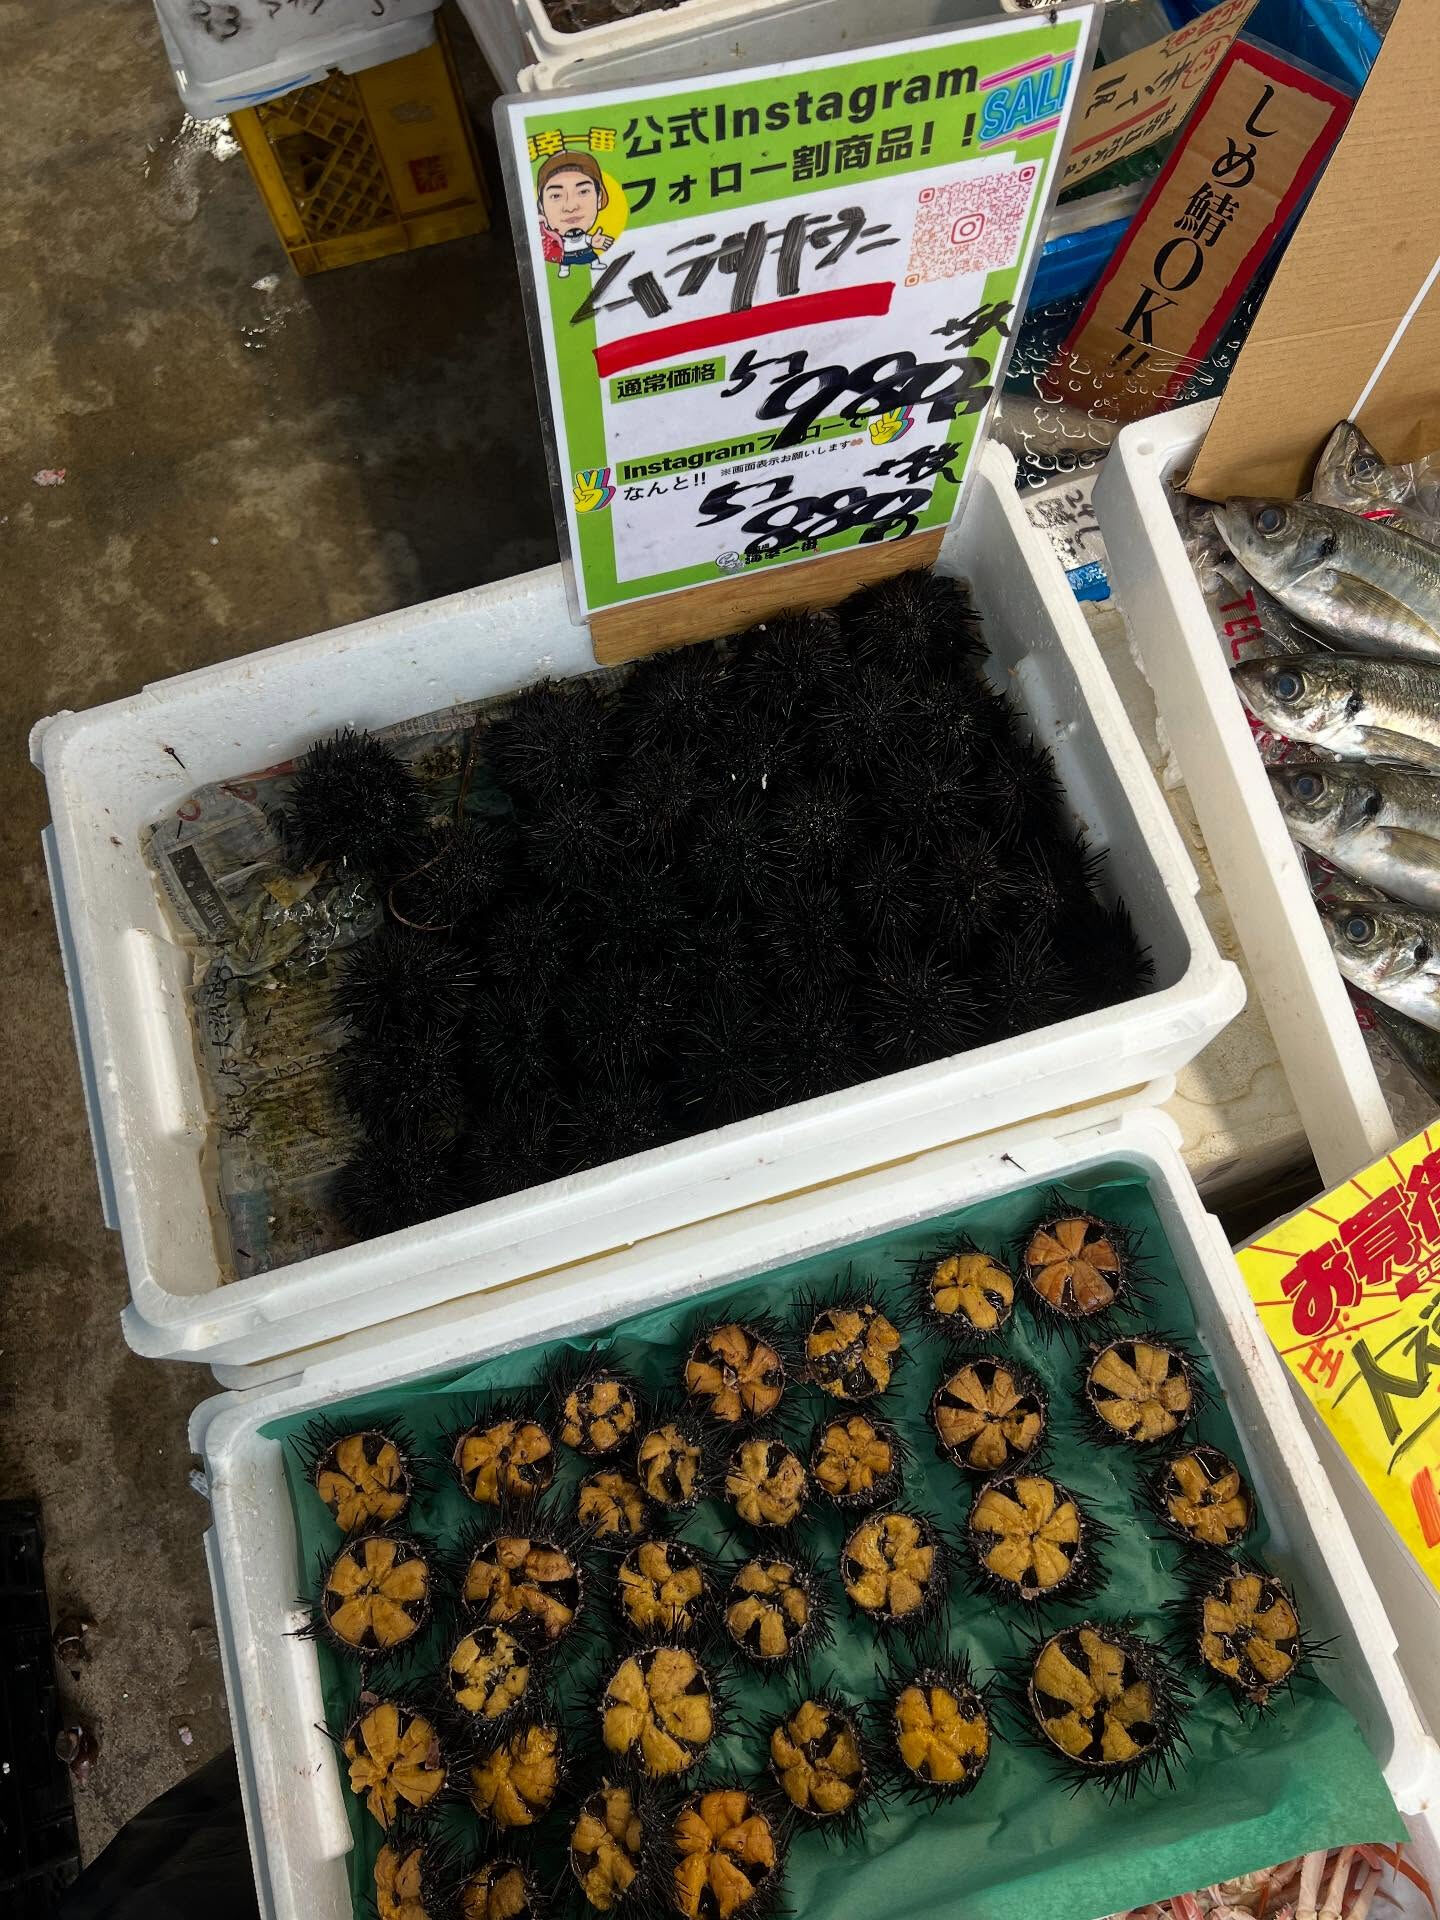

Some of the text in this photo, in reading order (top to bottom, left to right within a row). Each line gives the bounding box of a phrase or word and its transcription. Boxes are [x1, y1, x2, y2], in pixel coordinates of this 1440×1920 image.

[622, 64, 979, 160] 公式Instagram
[617, 363, 716, 399] 通常価格
[623, 416, 866, 481] Instagramフローで
[623, 472, 707, 502] なんと!!
[1219, 589, 1264, 660] TEL
